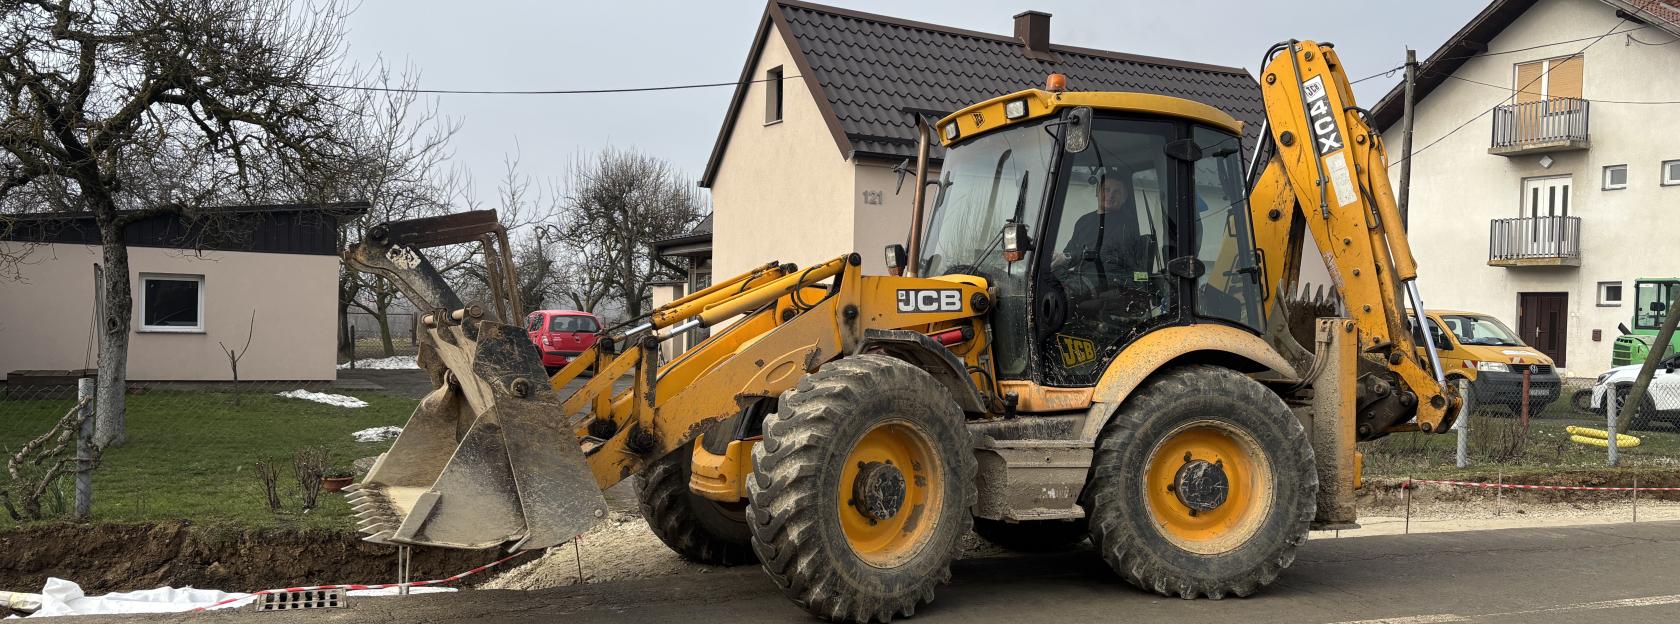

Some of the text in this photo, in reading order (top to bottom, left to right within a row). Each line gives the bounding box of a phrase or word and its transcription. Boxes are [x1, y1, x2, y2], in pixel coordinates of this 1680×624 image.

[1305, 83, 1320, 96] JCB
[1310, 100, 1341, 153] 4CX
[863, 190, 882, 204] 121
[898, 290, 961, 311] JCB
[1062, 336, 1096, 366] JCB
